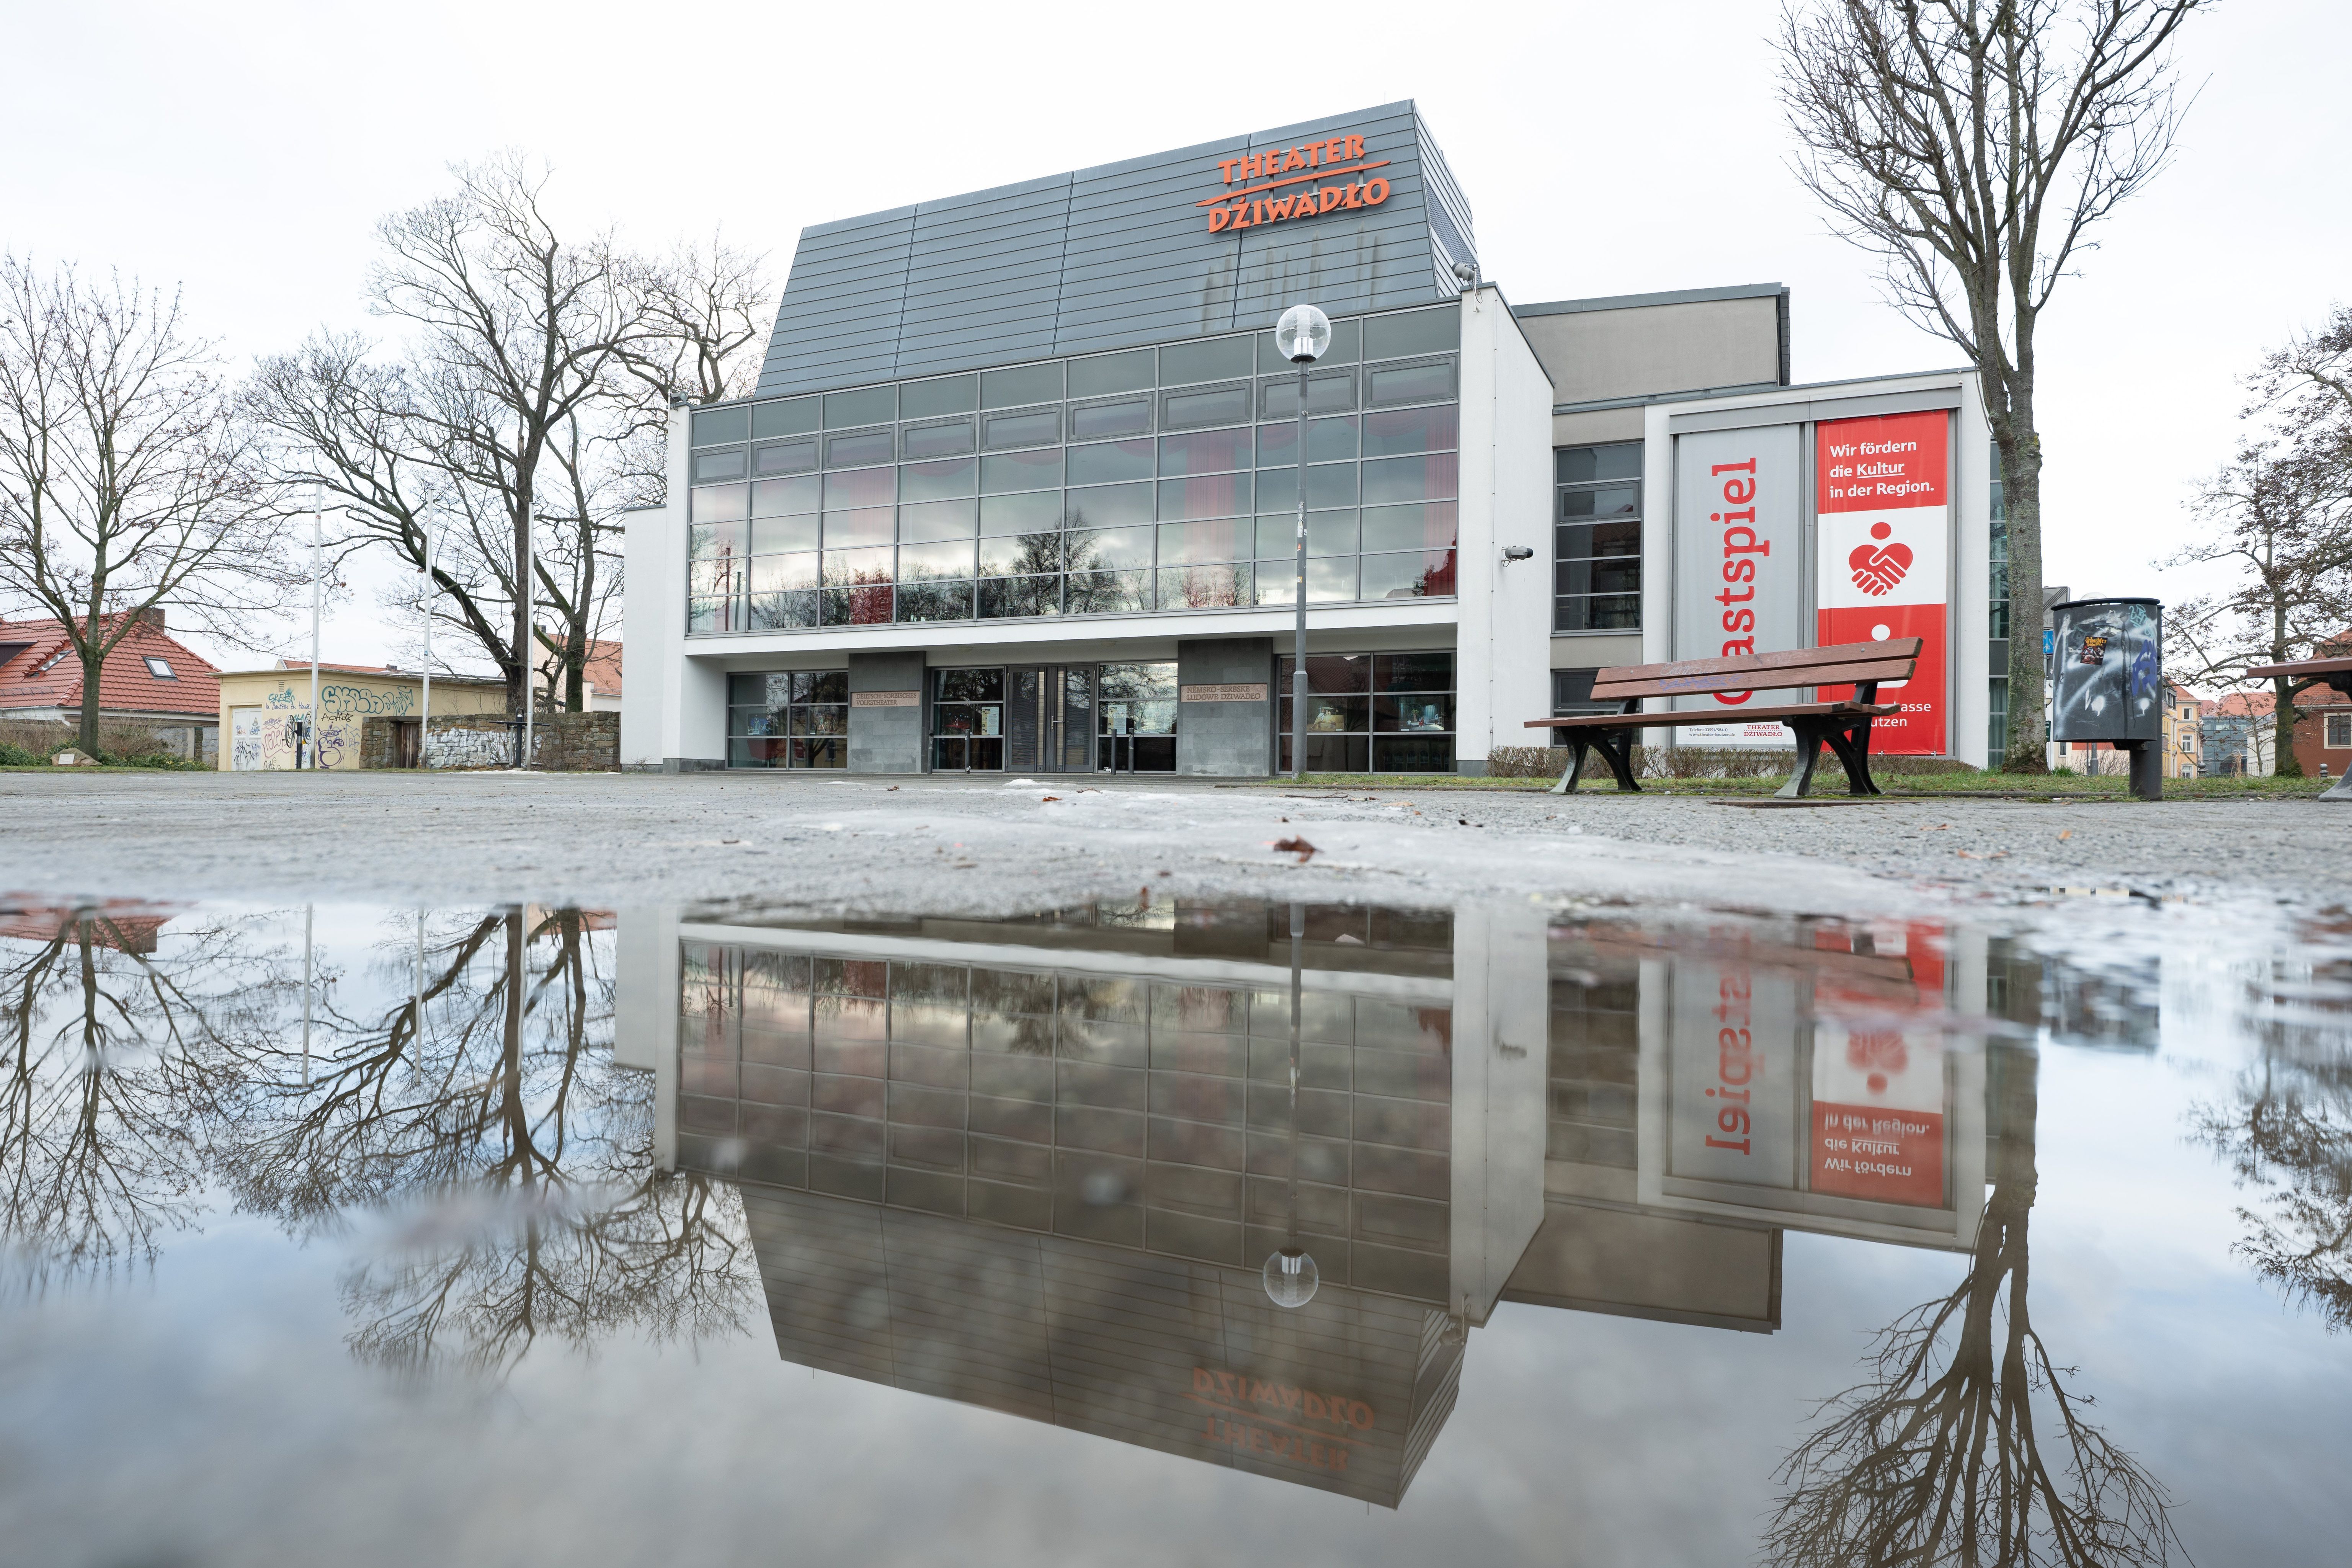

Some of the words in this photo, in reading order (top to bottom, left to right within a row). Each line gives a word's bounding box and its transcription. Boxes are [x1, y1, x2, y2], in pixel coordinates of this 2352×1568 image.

[1218, 134, 1366, 184] THEATER
[1209, 178, 1390, 234] DŹIWADŁO
[1829, 444, 1857, 457] Wir
[1860, 440, 1917, 455] fördern
[1830, 465, 1852, 478] die
[1857, 462, 1904, 477] Kultur
[1829, 486, 1843, 498] in
[1847, 484, 1873, 497] der
[1877, 480, 1934, 497] Region.
[1710, 457, 1770, 705] astspiel
[1894, 701, 1931, 712] asse
[1871, 717, 1907, 727] utzen
